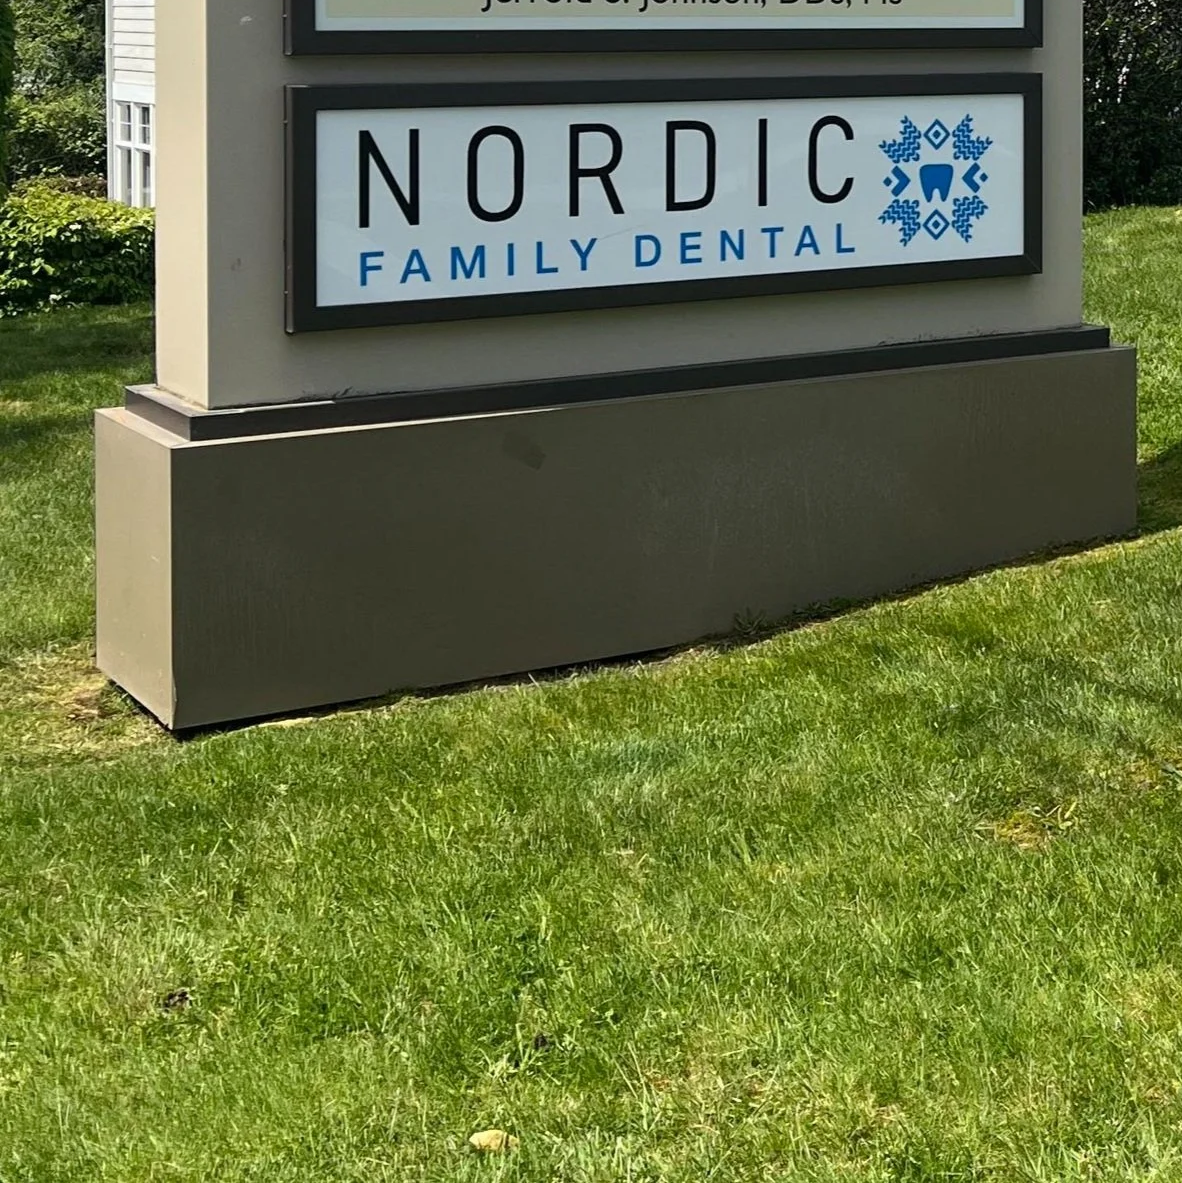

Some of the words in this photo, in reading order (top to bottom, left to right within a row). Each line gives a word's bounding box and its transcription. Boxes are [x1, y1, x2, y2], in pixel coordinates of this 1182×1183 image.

[357, 114, 855, 229] NORDIC
[360, 237, 599, 287] FAMILY
[635, 222, 856, 268] DENTAL
